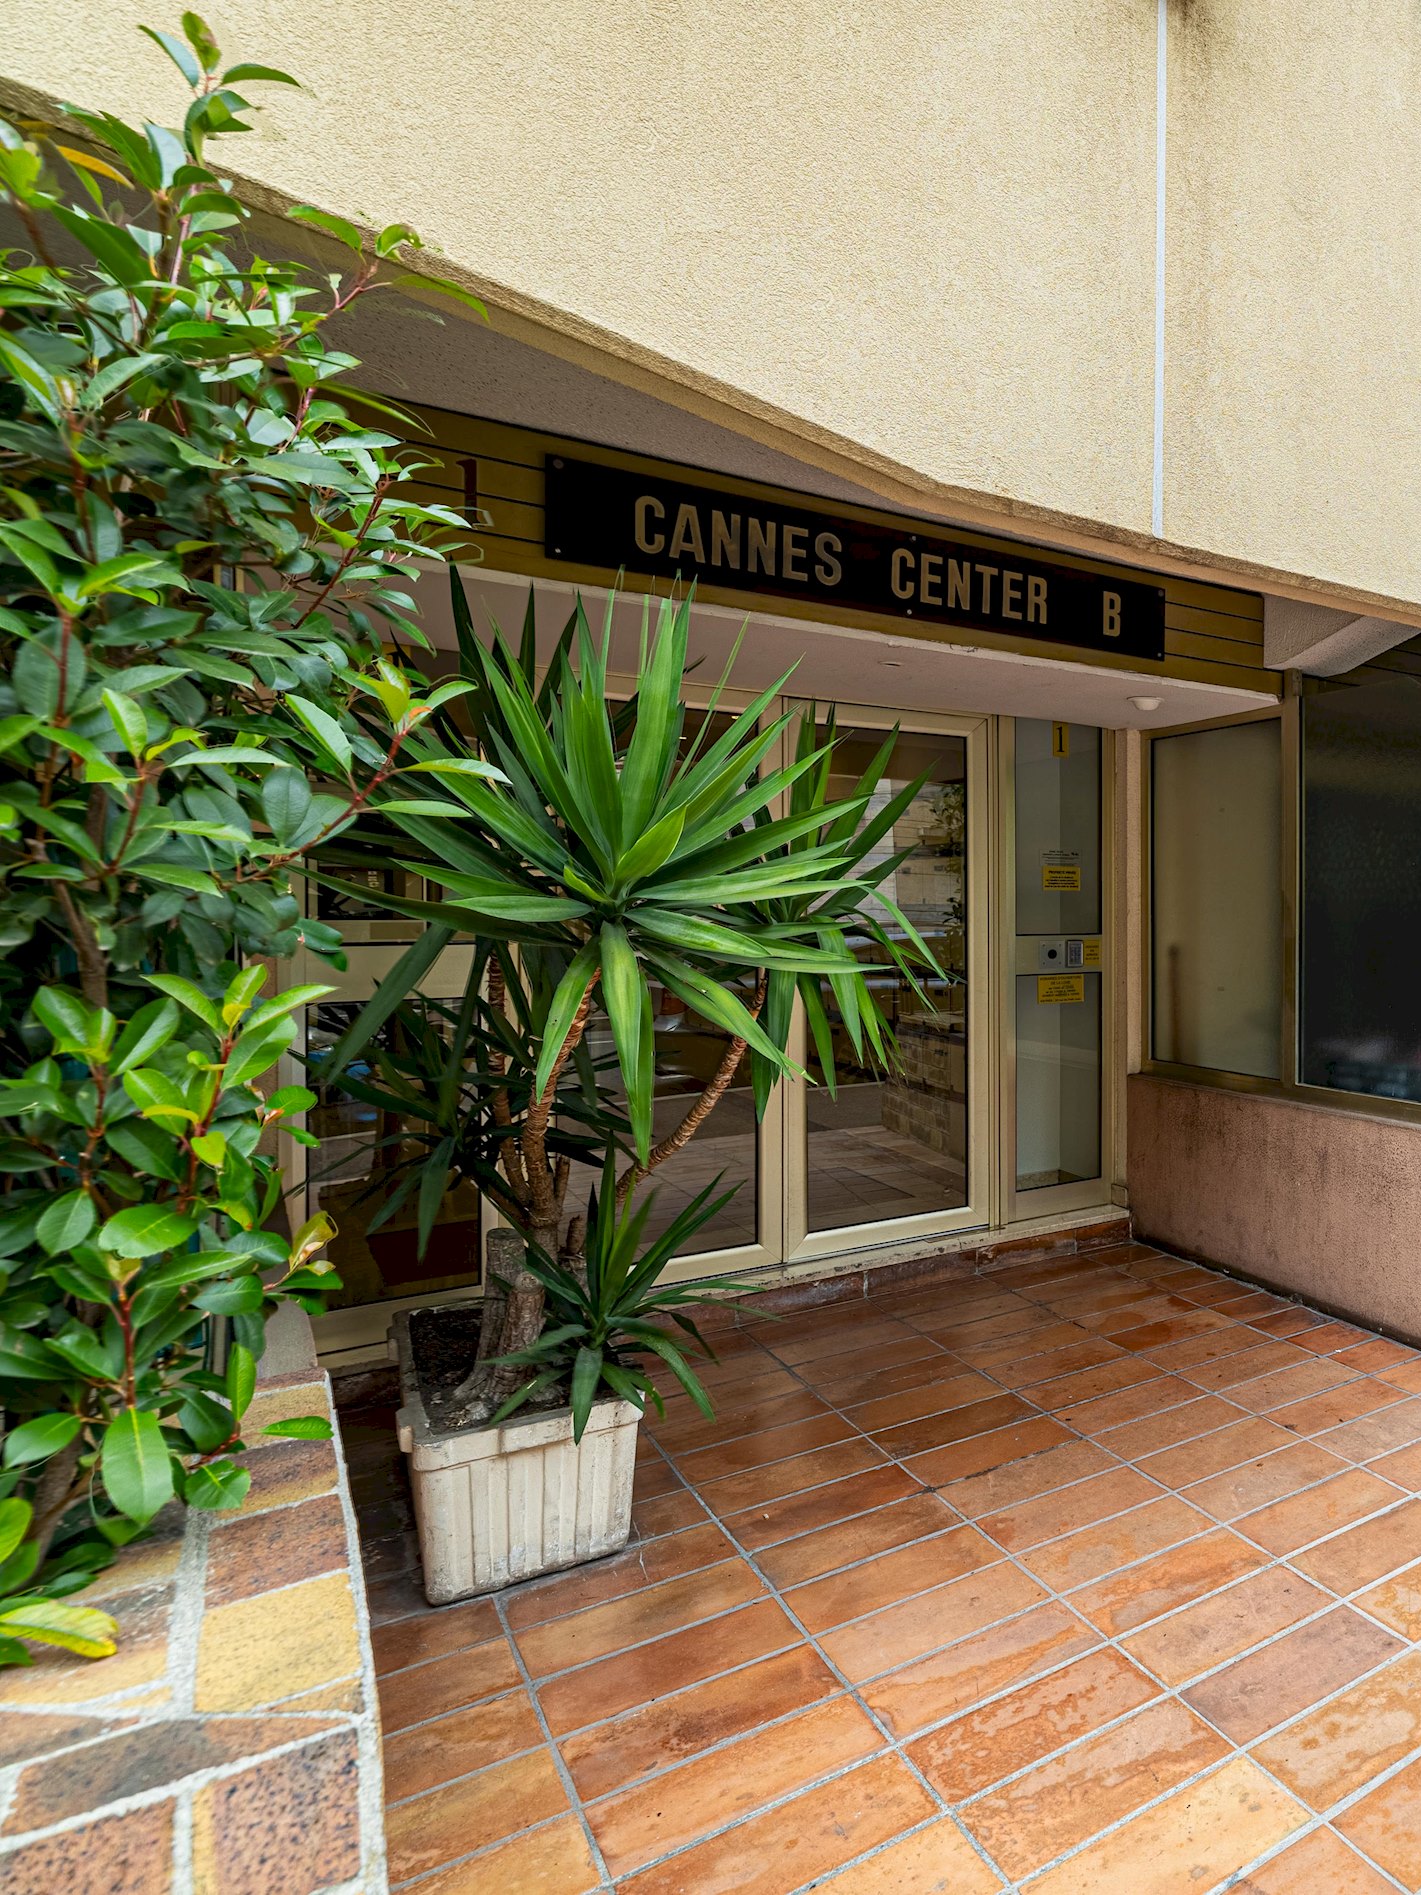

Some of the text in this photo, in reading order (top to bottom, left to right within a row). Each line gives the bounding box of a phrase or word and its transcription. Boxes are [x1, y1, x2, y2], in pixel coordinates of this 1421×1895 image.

[634, 495, 1121, 637] CANNES CENTER B
[1056, 726, 1065, 753] 1
